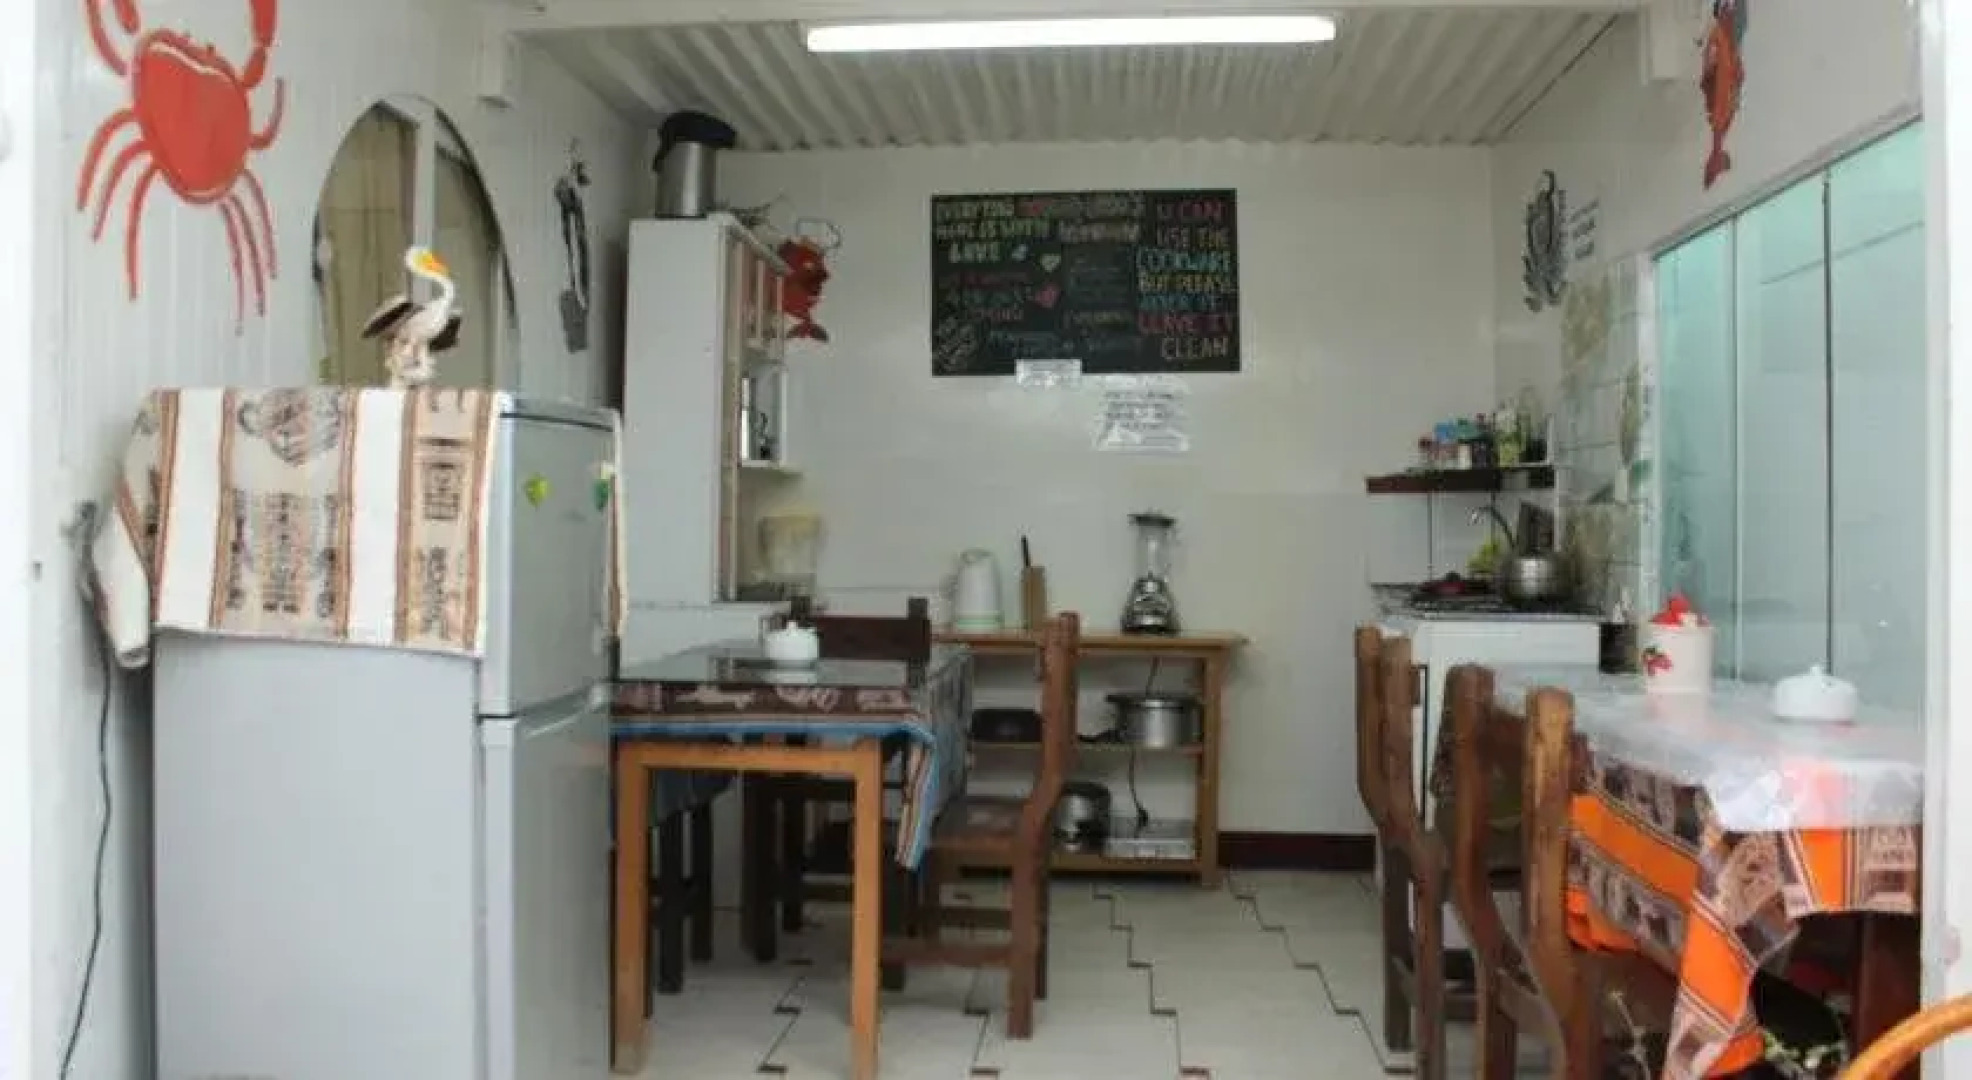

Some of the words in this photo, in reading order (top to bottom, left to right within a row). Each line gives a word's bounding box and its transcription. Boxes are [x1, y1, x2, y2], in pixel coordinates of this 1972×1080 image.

[1176, 199, 1224, 221] CAN
[1156, 227, 1190, 248] USE
[1195, 226, 1230, 248] THE
[948, 242, 1001, 263] LOVE
[1136, 247, 1230, 271] COOKWARE
[1138, 272, 1171, 292] BUT
[1161, 337, 1229, 361] CLEAN
